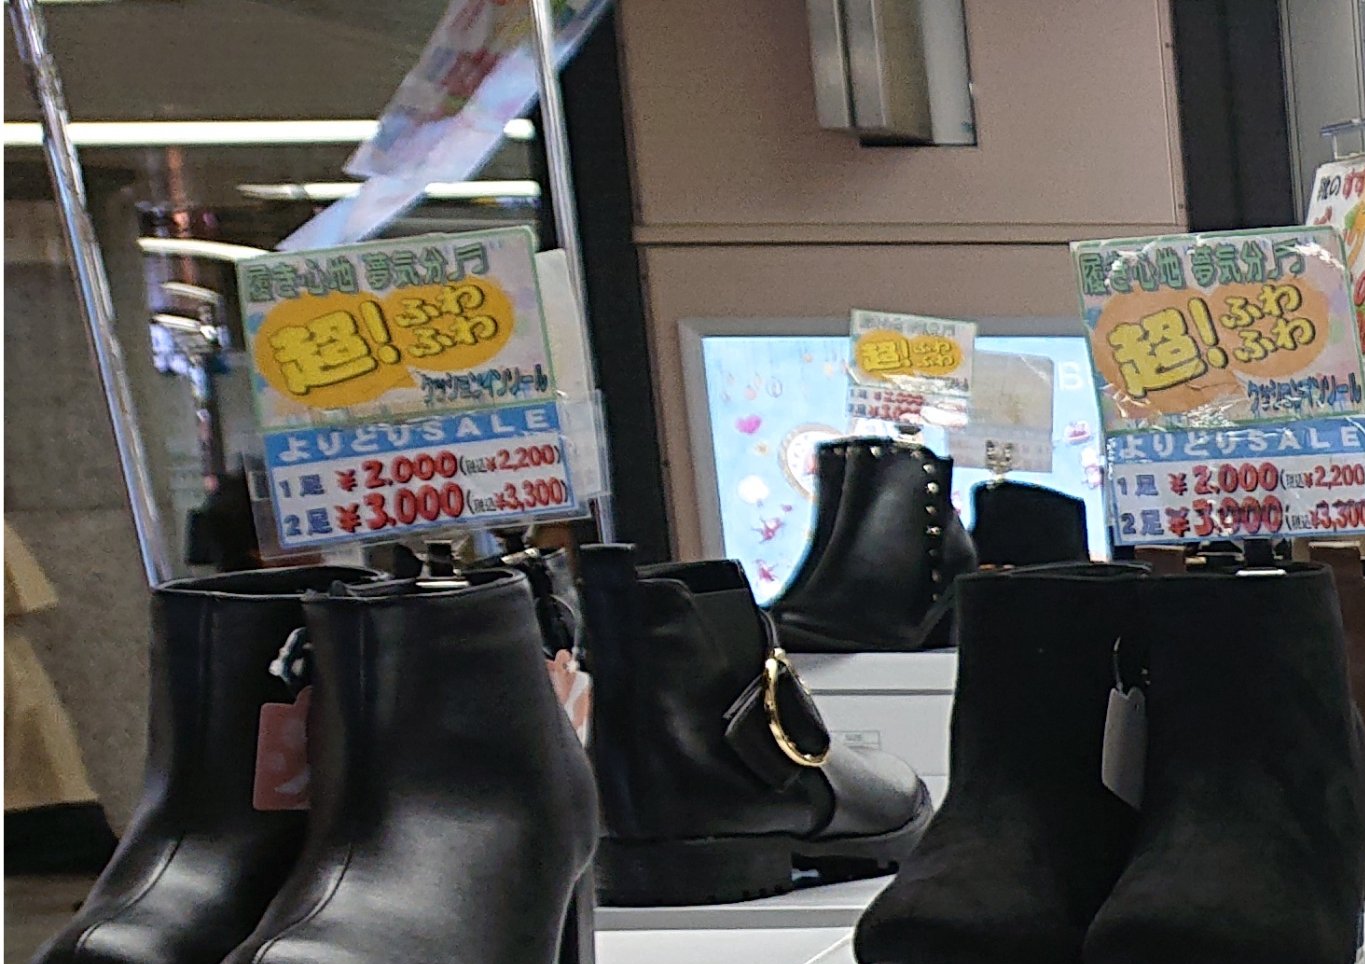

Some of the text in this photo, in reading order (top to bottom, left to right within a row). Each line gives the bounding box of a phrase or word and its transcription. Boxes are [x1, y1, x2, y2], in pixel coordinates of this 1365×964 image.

[395, 284, 485, 327] ふわ
[1220, 284, 1302, 329] ふわ
[269, 300, 401, 395] 超!
[408, 314, 498, 357] ふわ
[1107, 297, 1228, 399] 超!
[1233, 317, 1315, 362] ふわ
